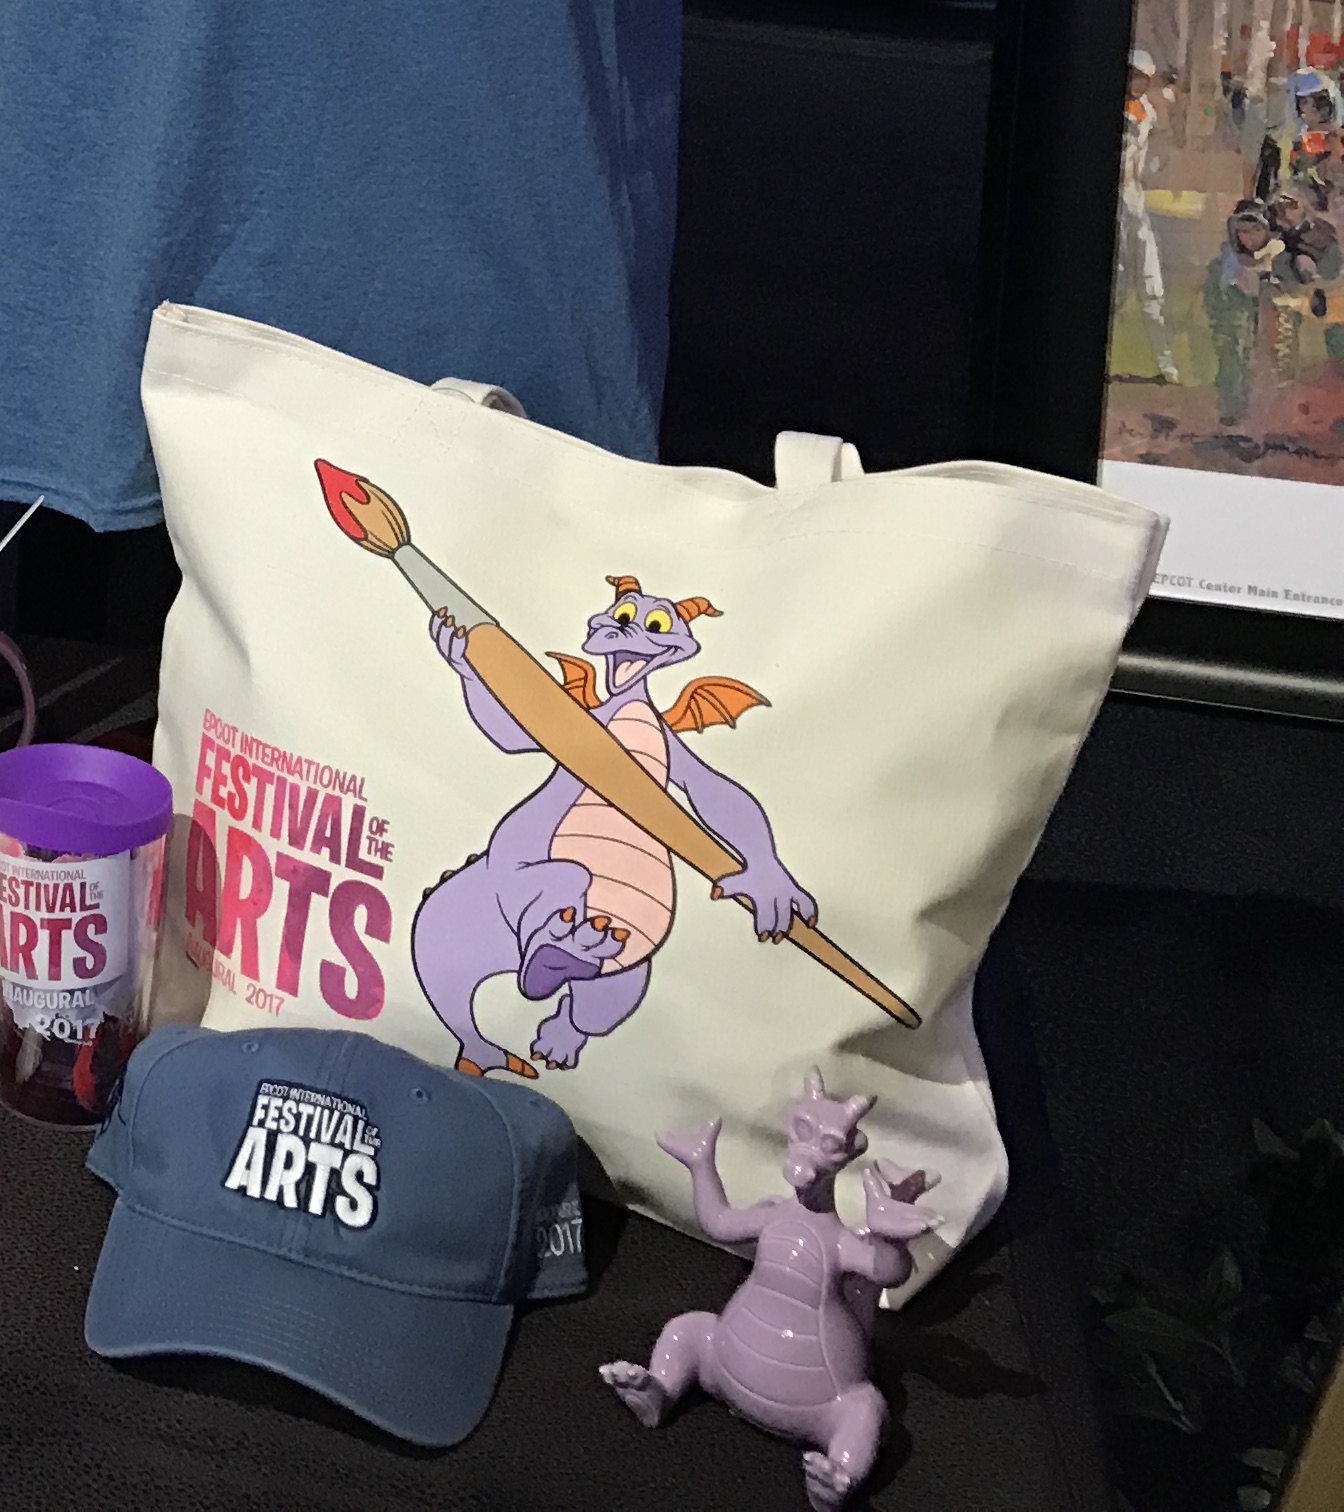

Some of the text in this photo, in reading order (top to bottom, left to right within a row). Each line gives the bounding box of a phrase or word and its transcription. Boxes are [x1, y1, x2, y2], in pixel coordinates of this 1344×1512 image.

[1154, 573, 1194, 588] EPCOT
[1199, 579, 1243, 594] Center
[1247, 585, 1279, 599] Main
[203, 707, 368, 802] EPCOT INTERNATIONAL
[195, 731, 395, 881] FESTIVAL OF THE
[12, 865, 87, 881] INTERNATIONAL
[185, 798, 393, 1021] ARTS
[245, 983, 285, 1016] 2017
[36, 1014, 104, 1040] 2017
[289, 1088, 367, 1119] INTERNATIONAL
[252, 1095, 375, 1156] FESTIVAL
[225, 1126, 378, 1228] ARTS
[536, 1218, 583, 1257] 2017
